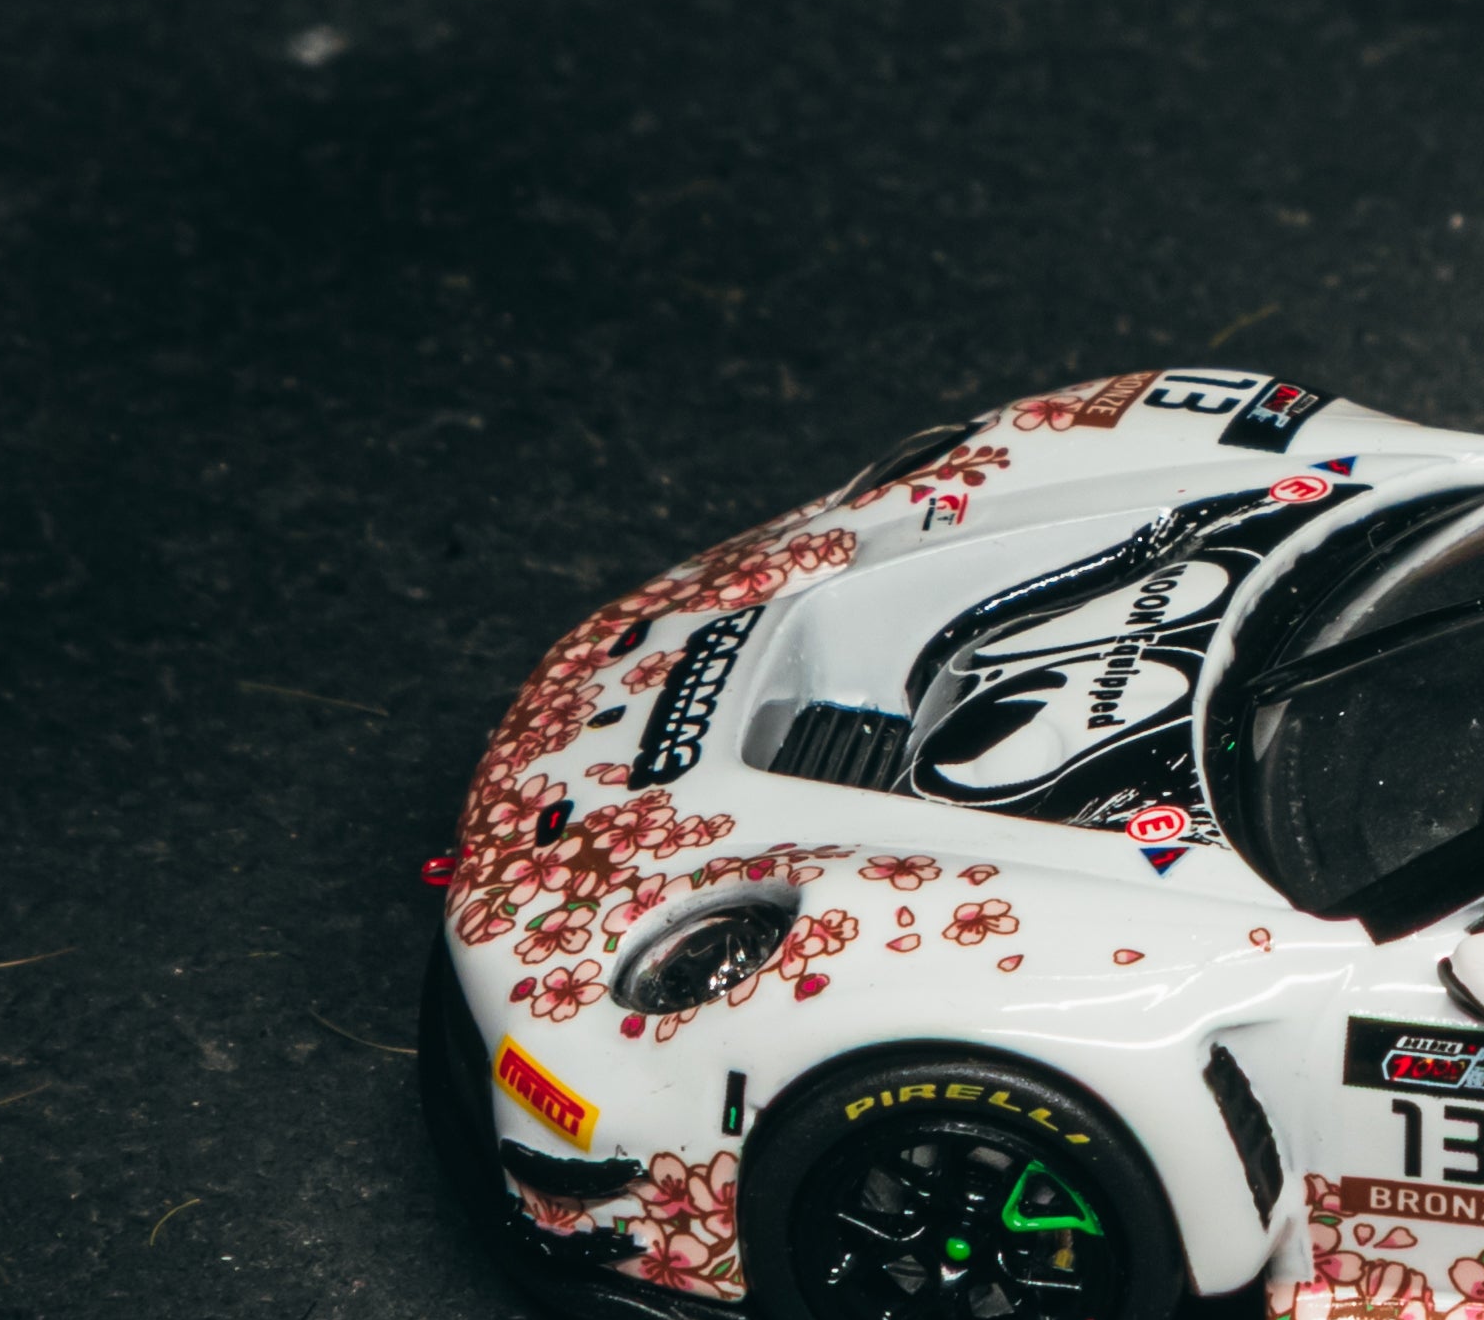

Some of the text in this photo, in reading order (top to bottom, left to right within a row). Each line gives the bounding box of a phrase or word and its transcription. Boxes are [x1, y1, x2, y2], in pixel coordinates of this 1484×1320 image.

[1144, 375, 1258, 415] 13
[651, 607, 759, 773] TARMAC
[1087, 633, 1158, 729] Equipped
[845, 1084, 1091, 1144] PIRELLI
